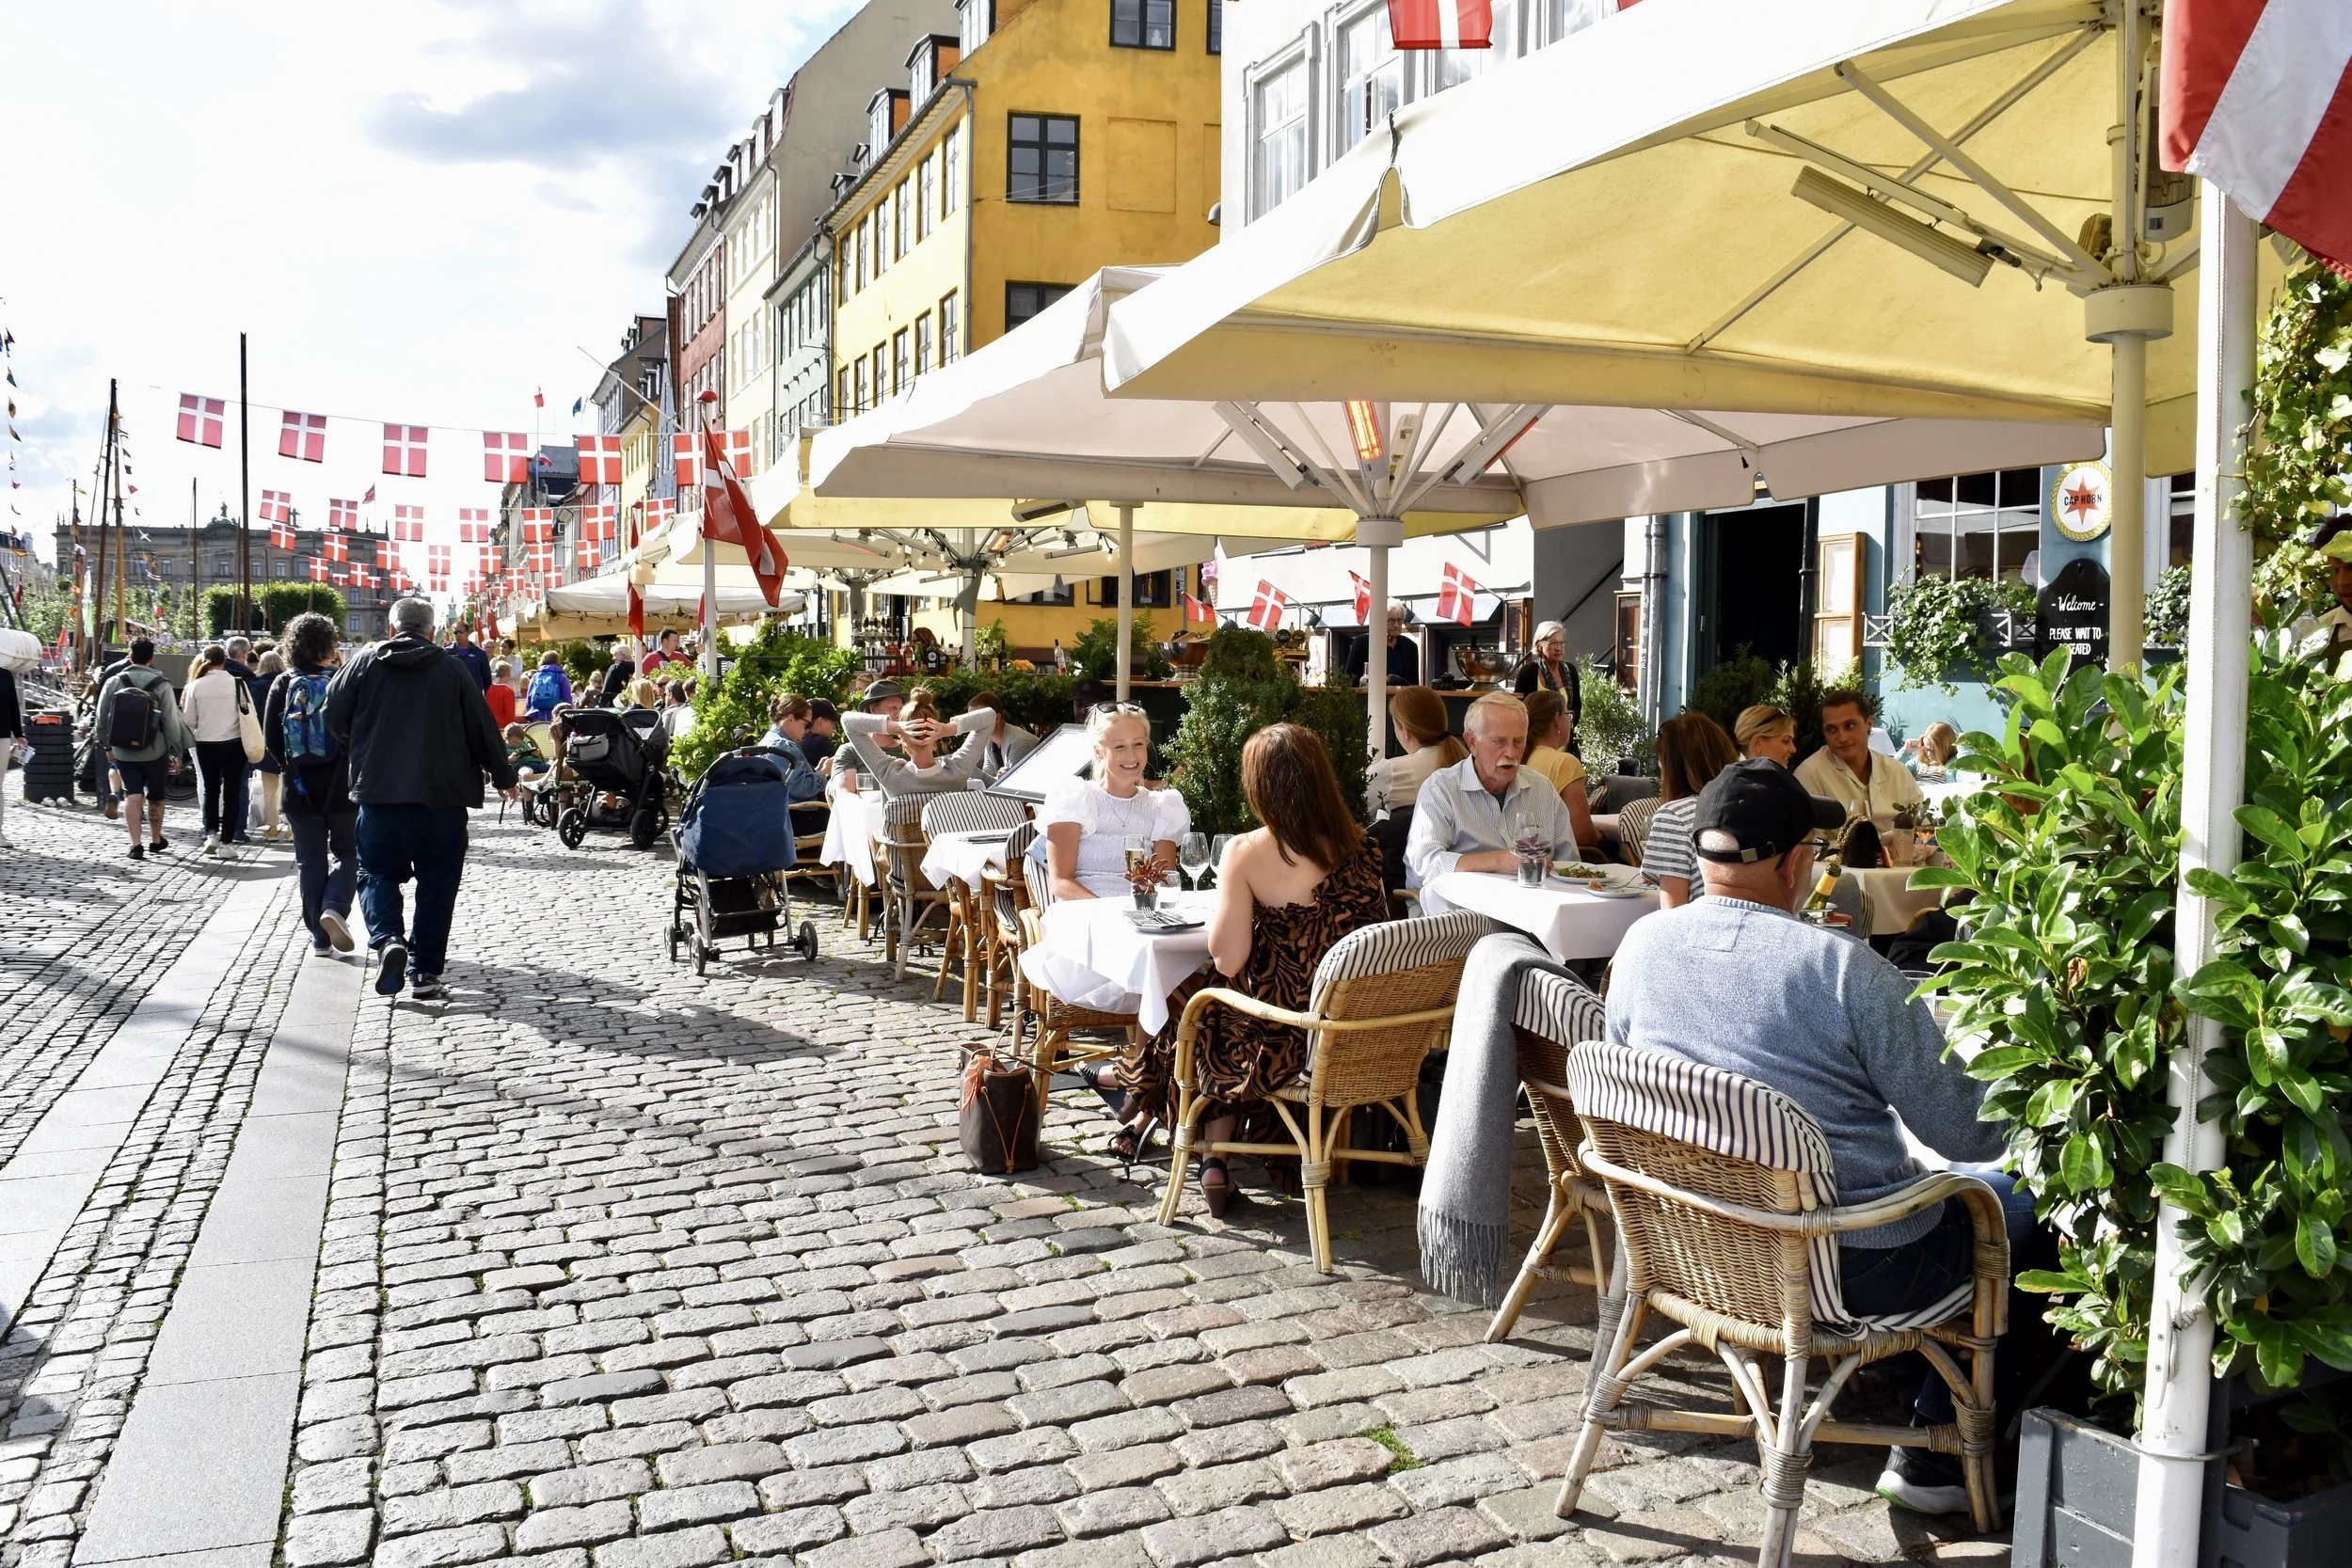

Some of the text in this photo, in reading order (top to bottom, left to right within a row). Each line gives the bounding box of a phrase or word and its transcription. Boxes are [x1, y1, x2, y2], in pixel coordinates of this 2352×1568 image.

[2064, 496, 2078, 506] CAP
[2058, 594, 2096, 611] Welcome
[2049, 627, 2101, 640] PLEASE WAIT TO
[2068, 643, 2091, 656] EATED
